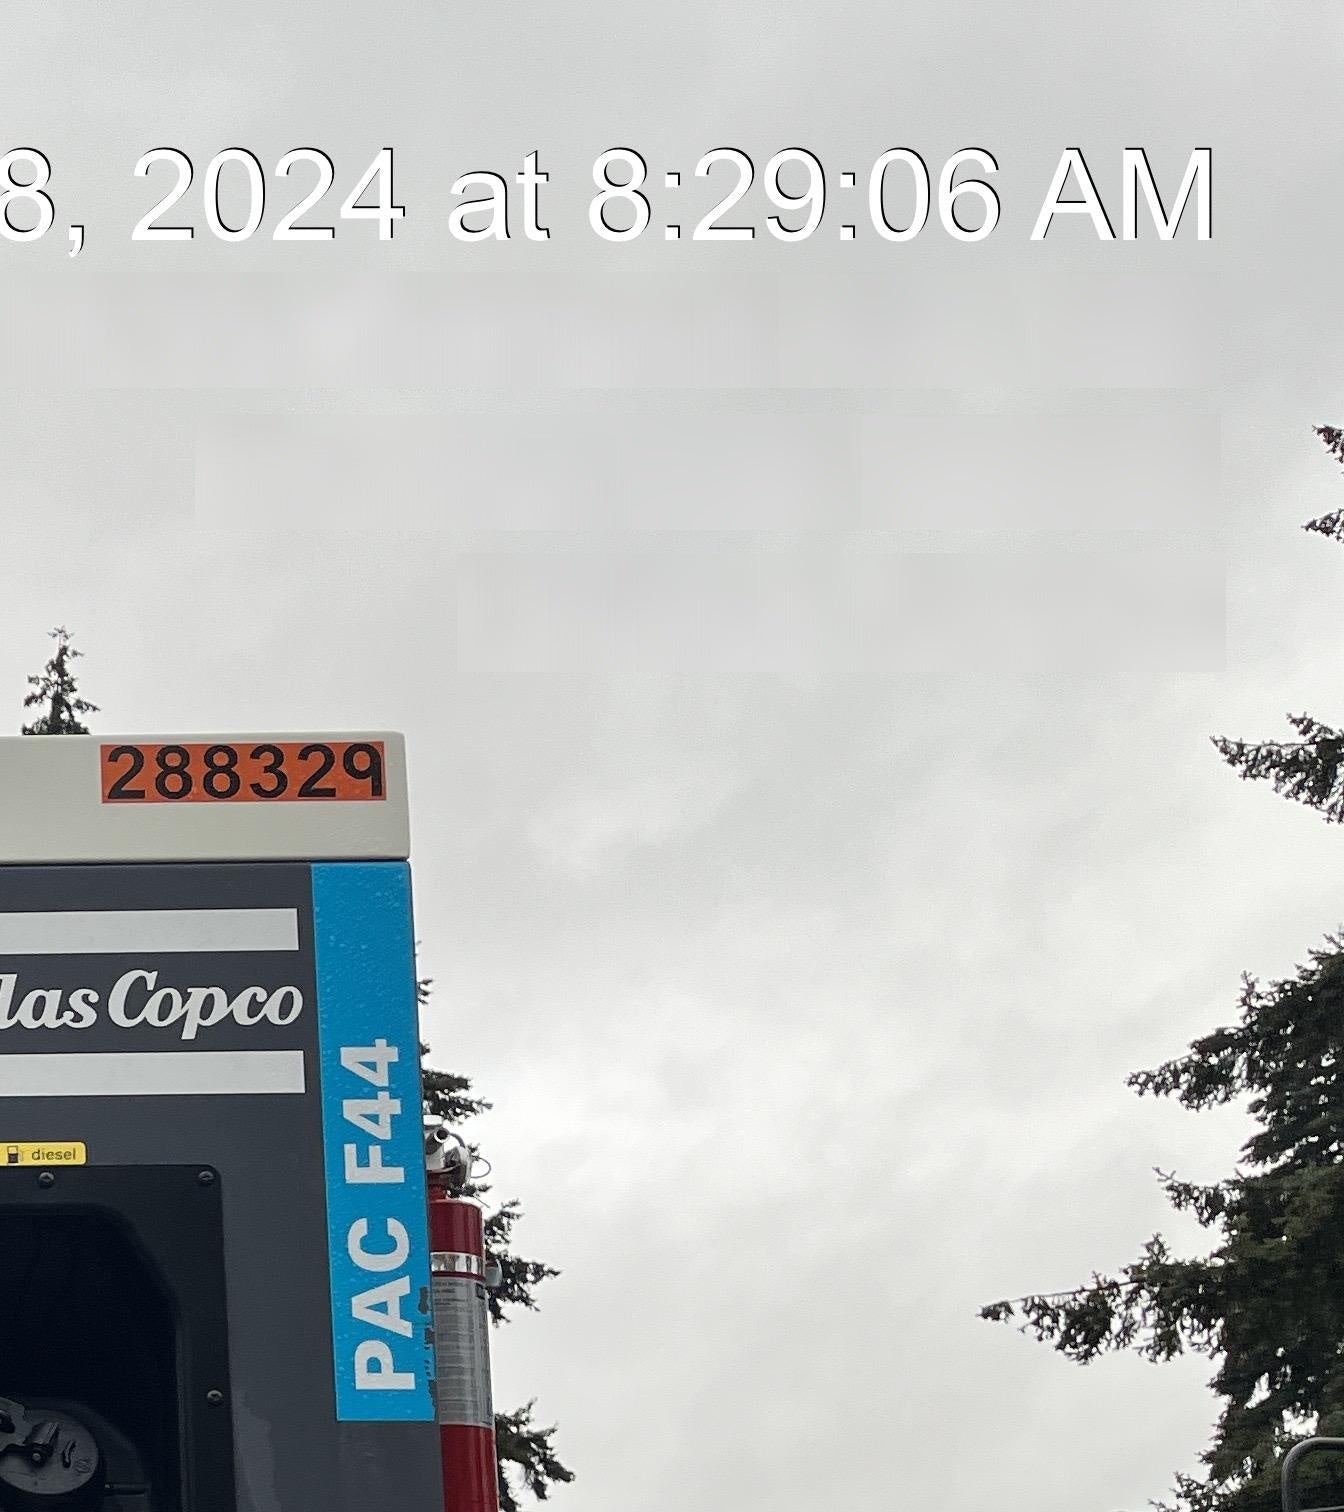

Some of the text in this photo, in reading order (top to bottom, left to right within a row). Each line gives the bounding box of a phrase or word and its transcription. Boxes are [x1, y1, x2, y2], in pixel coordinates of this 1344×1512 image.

[107, 742, 383, 800] 288329
[108, 968, 304, 1040] Copco
[32, 1148, 76, 1160] diesel
[340, 1037, 416, 1391] PAC F44
